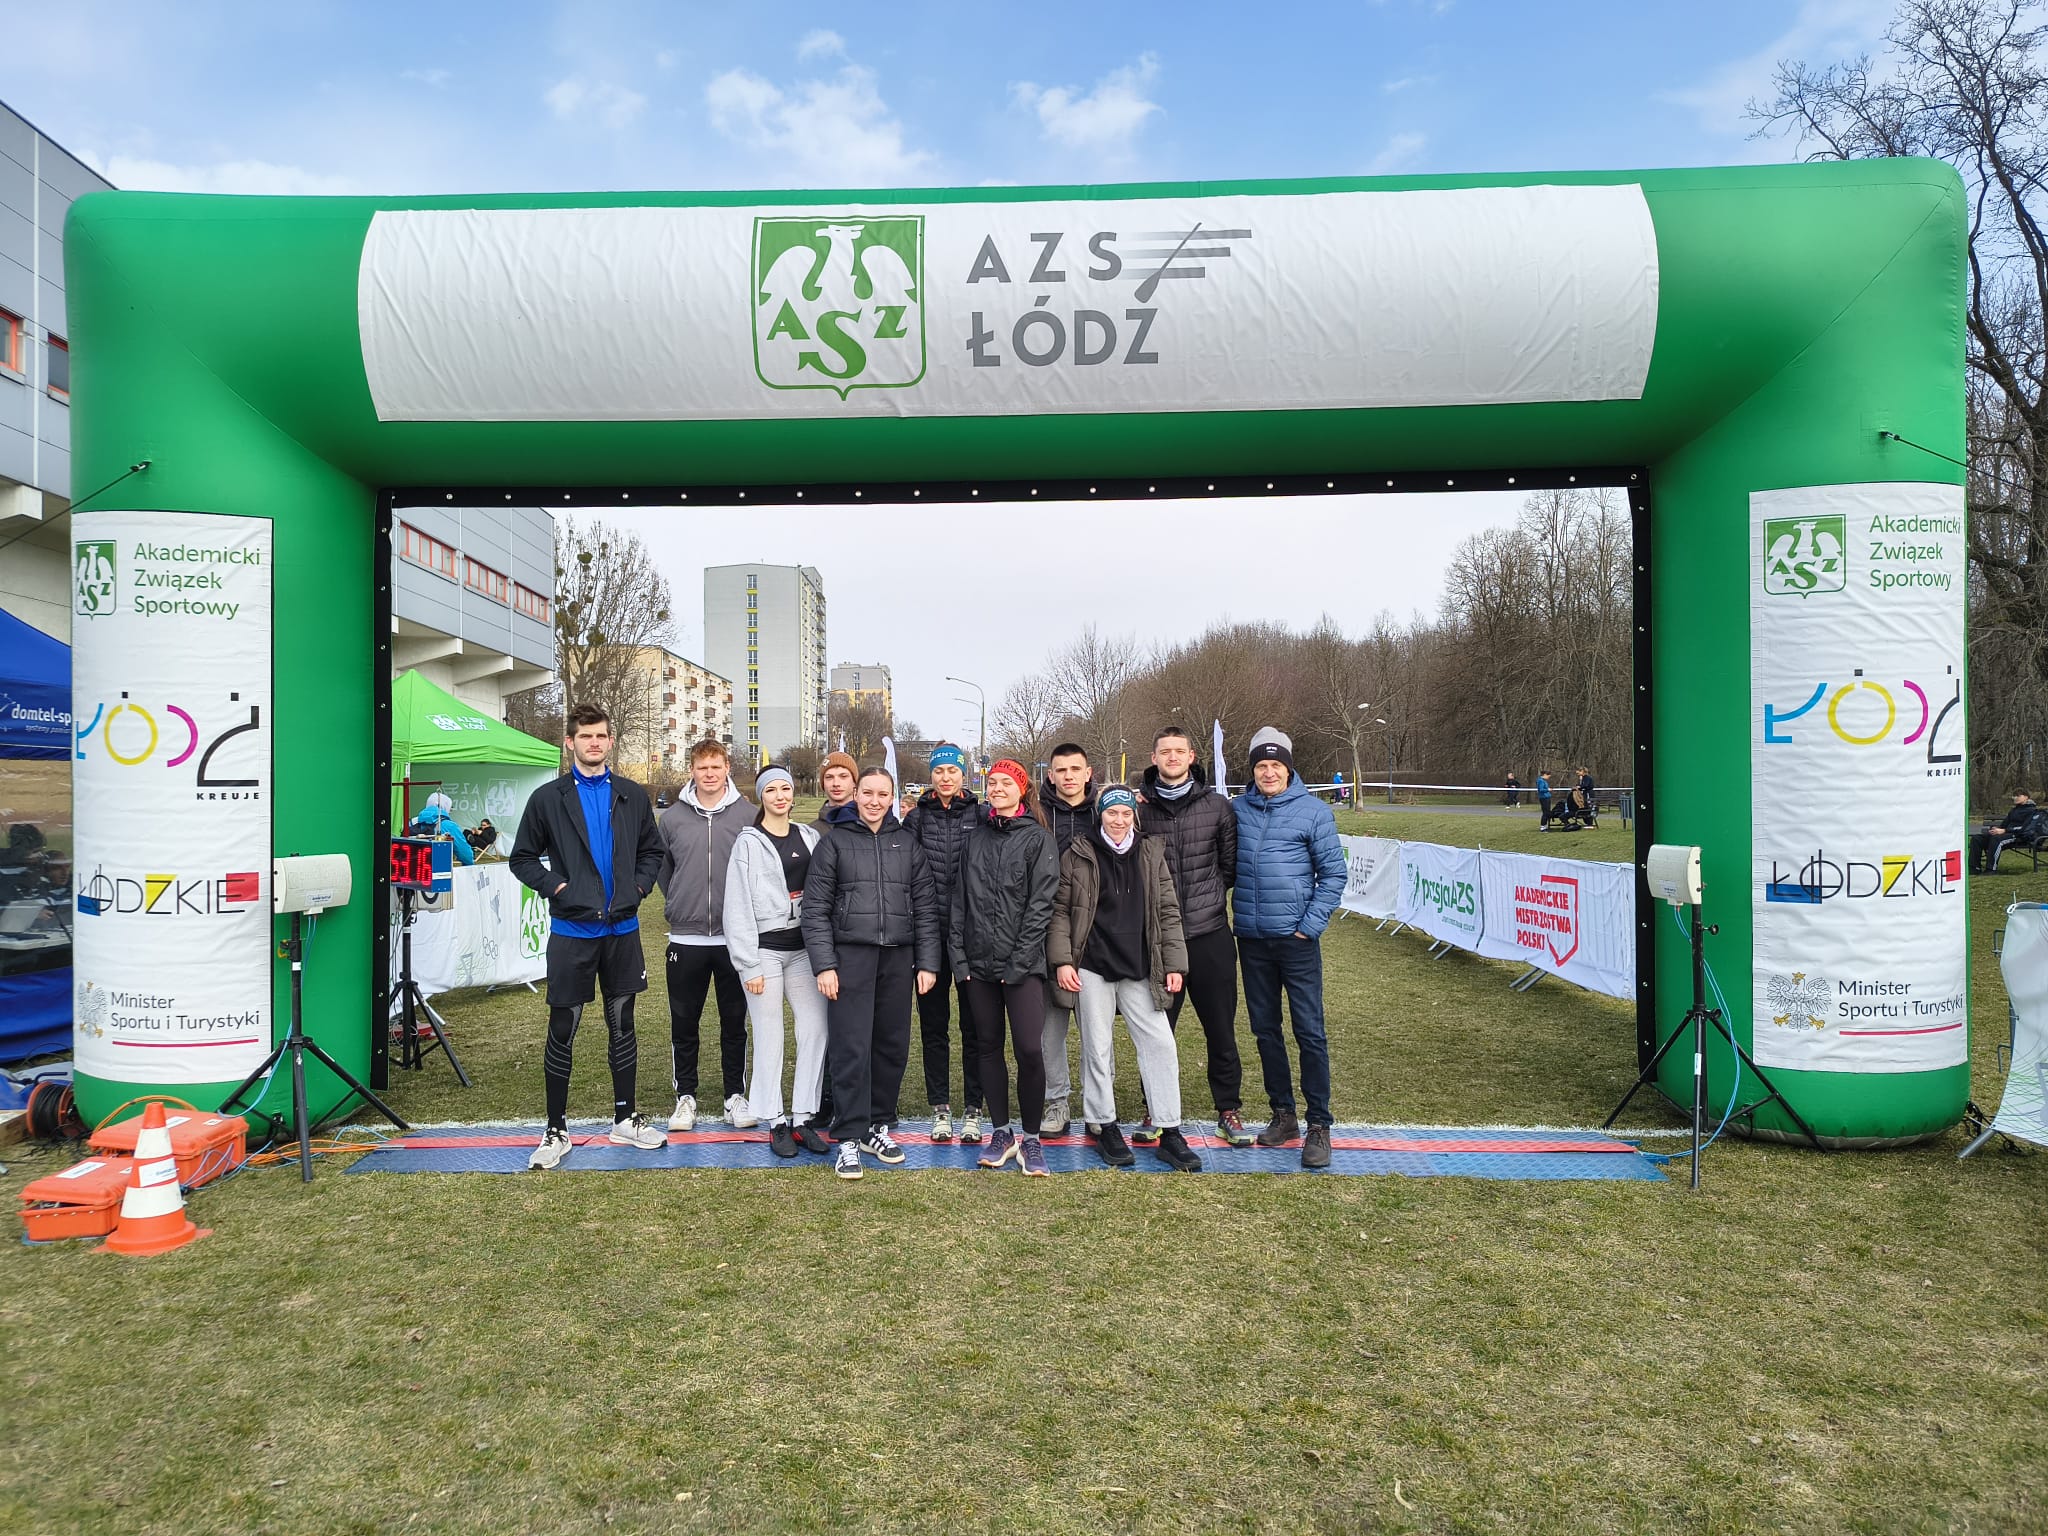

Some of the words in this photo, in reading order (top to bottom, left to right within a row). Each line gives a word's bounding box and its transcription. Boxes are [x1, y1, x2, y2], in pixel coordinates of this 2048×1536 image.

[966, 231, 1123, 285] AZS
[1869, 514, 1961, 534] Akademicki
[134, 543, 260, 565] Akademicki
[1869, 541, 1943, 564] Związek
[134, 569, 223, 591] Związek
[1869, 569, 1951, 591] Sportowy
[134, 595, 240, 621] Sportowy
[1927, 767, 1961, 778] KREUJE
[196, 792, 260, 800] KREUJE
[1517, 929, 1546, 951] POLSKI
[1838, 980, 1912, 996] Minister
[111, 991, 175, 1009] Minister
[1838, 1002, 1898, 1020] Sportu
[1903, 1001, 1907, 1016] i
[1912, 993, 1963, 1017] Turystyki
[111, 1012, 161, 1031] Sportu
[166, 1015, 170, 1029] i
[176, 1010, 260, 1032] Turystyki
